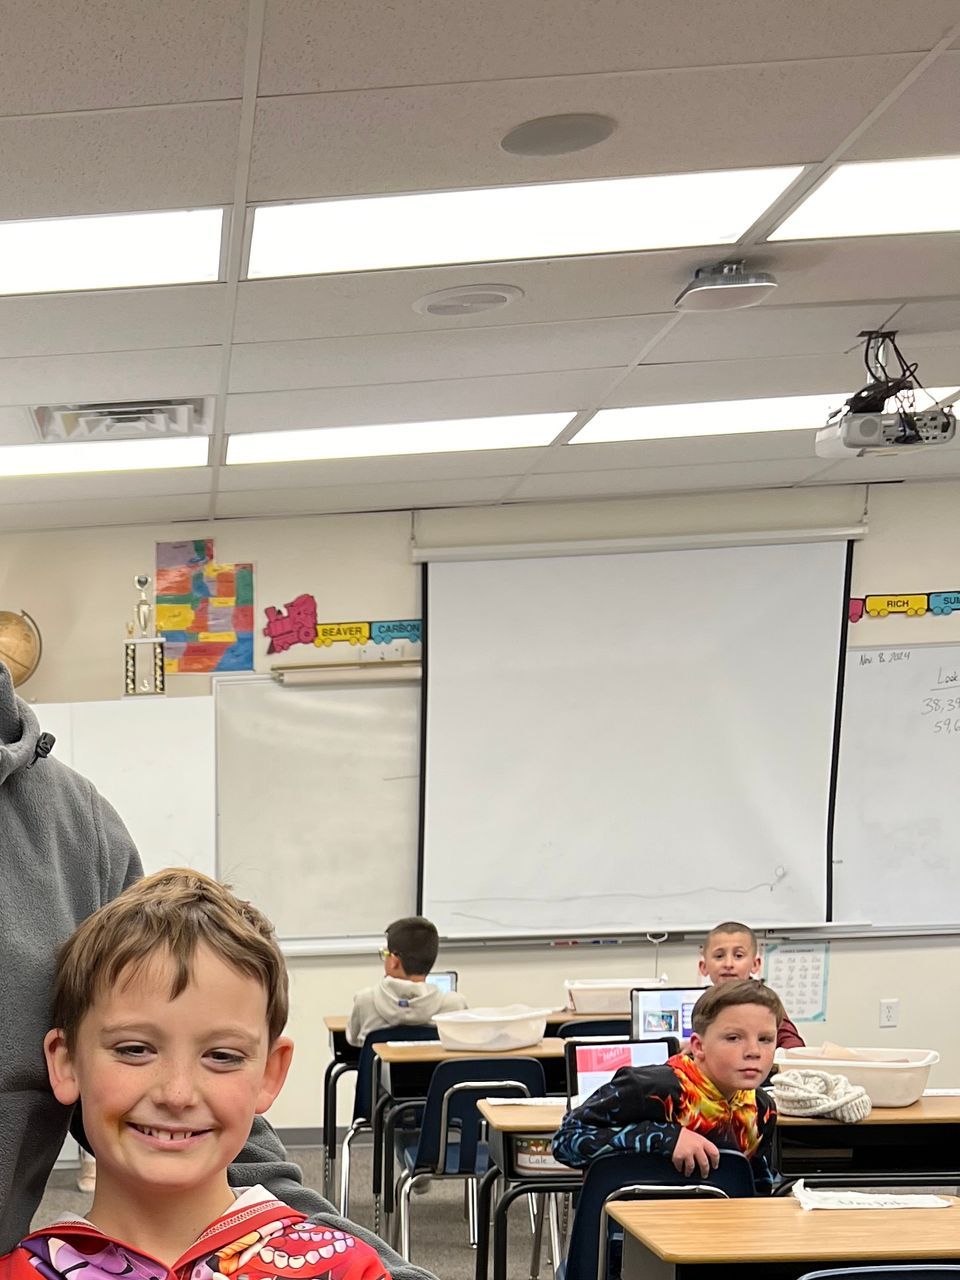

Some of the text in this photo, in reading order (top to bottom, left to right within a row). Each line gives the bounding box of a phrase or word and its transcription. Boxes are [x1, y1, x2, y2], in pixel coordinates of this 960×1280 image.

[887, 600, 909, 608] RICH
[322, 627, 362, 637] BEAVER
[378, 623, 420, 634] CARBON
